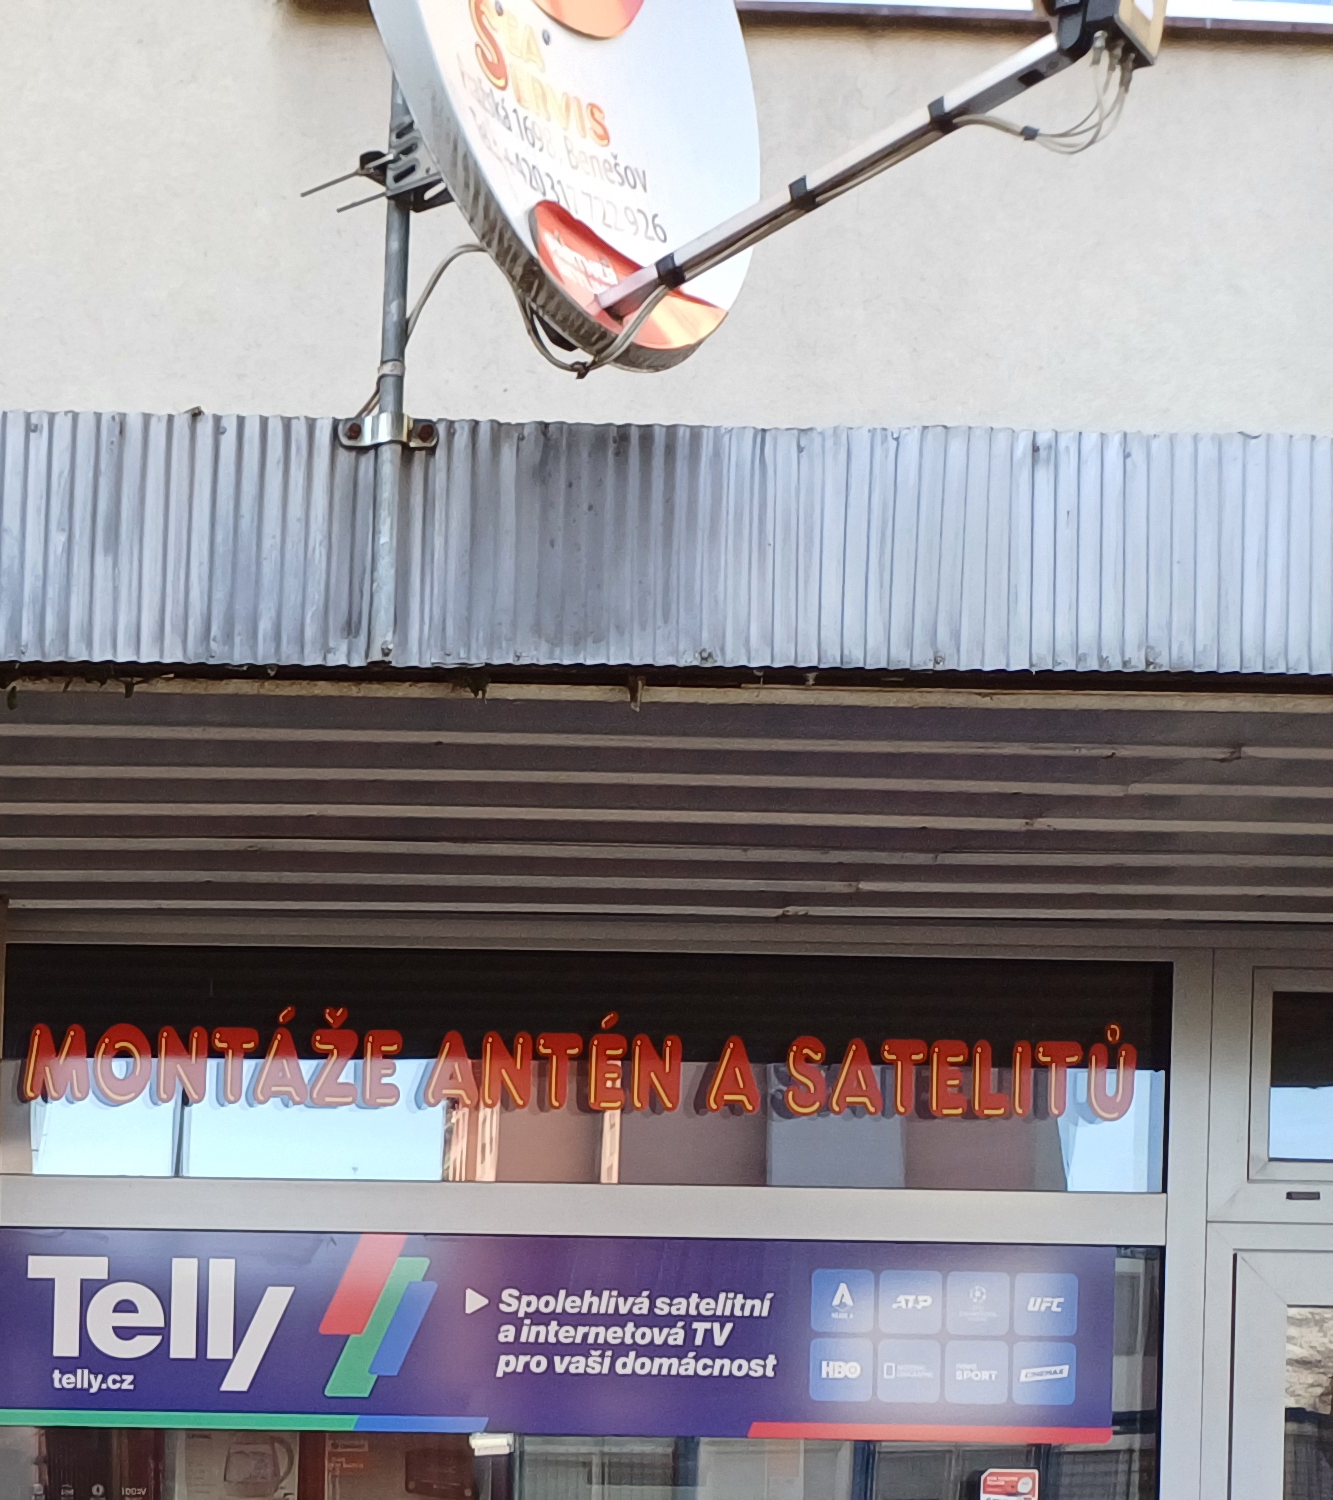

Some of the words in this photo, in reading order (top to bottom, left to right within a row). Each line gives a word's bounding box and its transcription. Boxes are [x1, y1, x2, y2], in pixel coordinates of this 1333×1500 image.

[564, 134, 648, 193] Benešov
[622, 206, 668, 243] 926
[23, 1005, 405, 1108] MONTÁŽE
[429, 1012, 683, 1112] ANTÉN
[707, 1035, 761, 1114] A
[782, 1020, 1138, 1122] SATELITŮ
[498, 1286, 651, 1318] Spolehlivá
[654, 1290, 773, 1320] satelitní
[892, 1294, 932, 1310] ATP
[1027, 1297, 1064, 1312] UFC
[27, 1255, 295, 1392] Telly
[498, 1326, 515, 1344] a
[519, 1318, 686, 1347] internetová
[692, 1321, 732, 1347] TV
[496, 1355, 550, 1378] pro
[553, 1348, 611, 1376] vaši
[614, 1347, 778, 1378] domácnost
[821, 1360, 862, 1379] HBO
[51, 1367, 136, 1394] telly.cz
